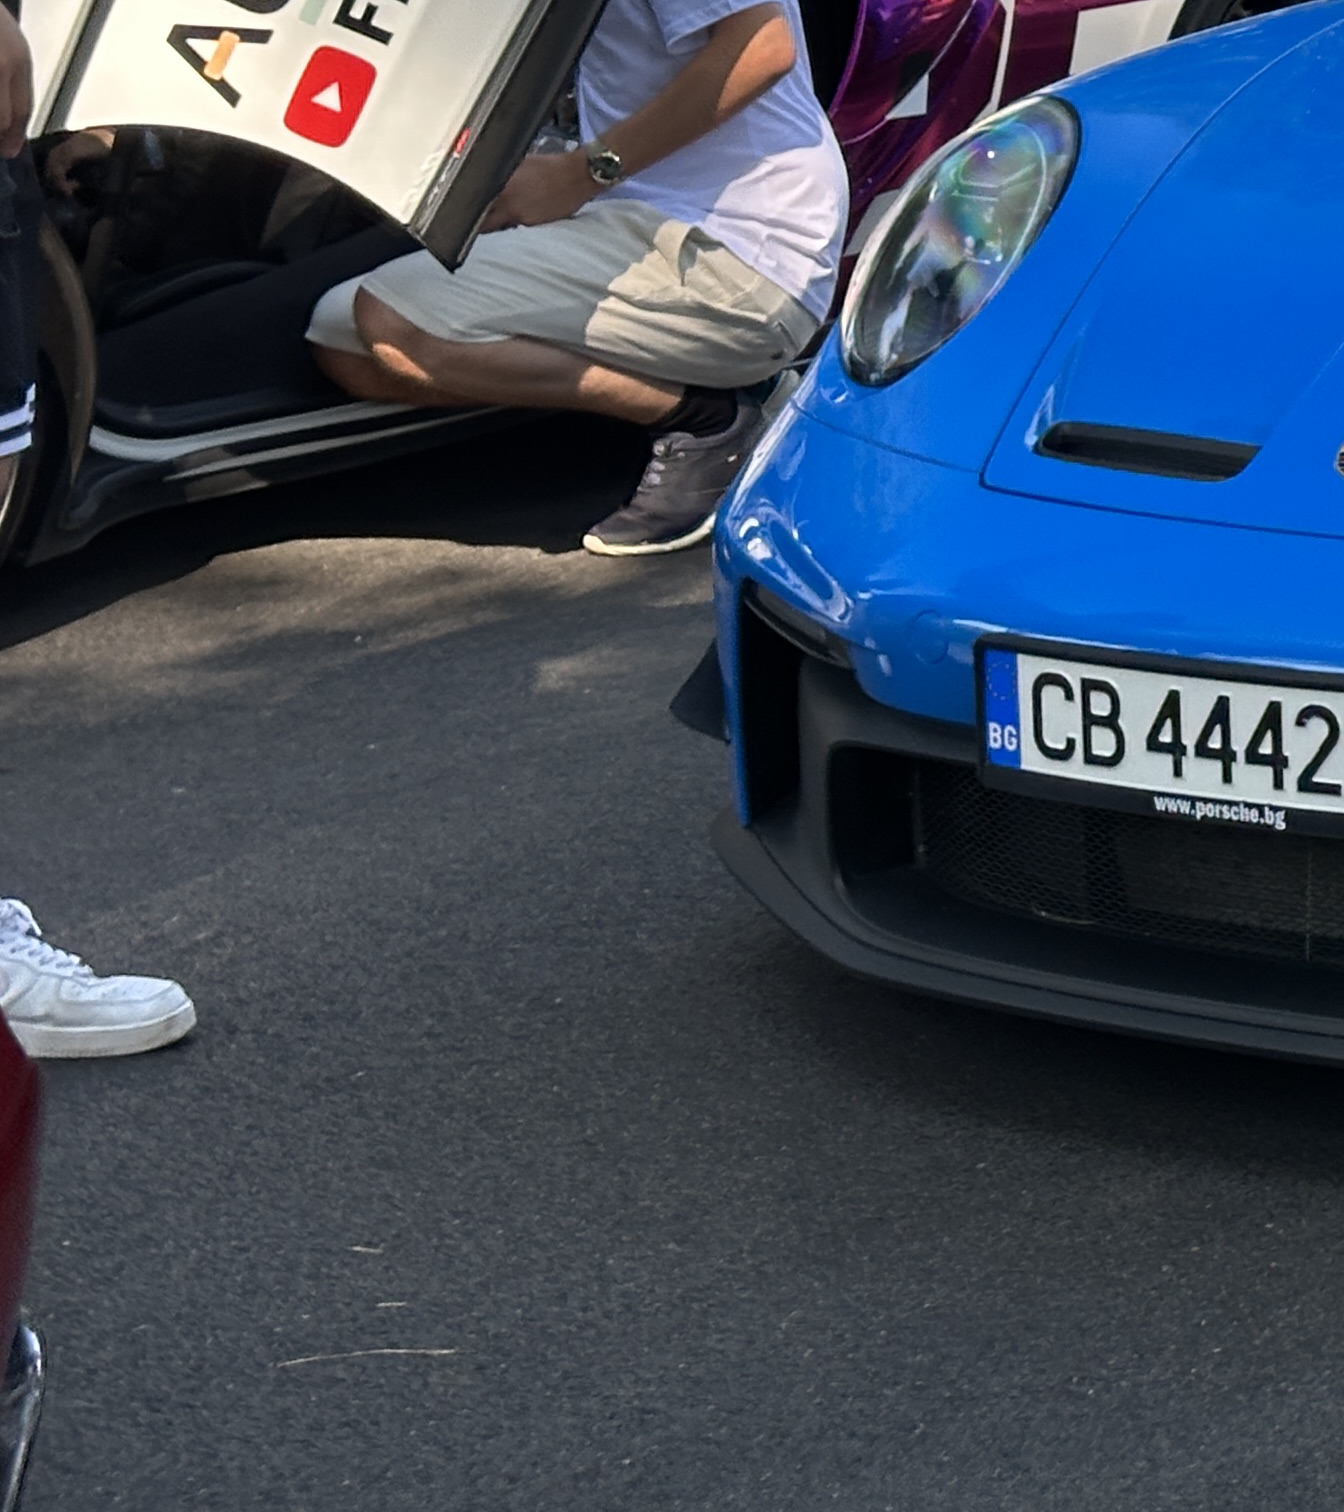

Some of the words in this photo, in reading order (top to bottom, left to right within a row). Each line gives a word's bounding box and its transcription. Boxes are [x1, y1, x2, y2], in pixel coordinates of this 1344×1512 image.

[988, 721, 1018, 751] BG
[1031, 671, 1126, 768] CB
[1145, 688, 1342, 797] 4442
[1153, 795, 1287, 830] www.porsche.bg
